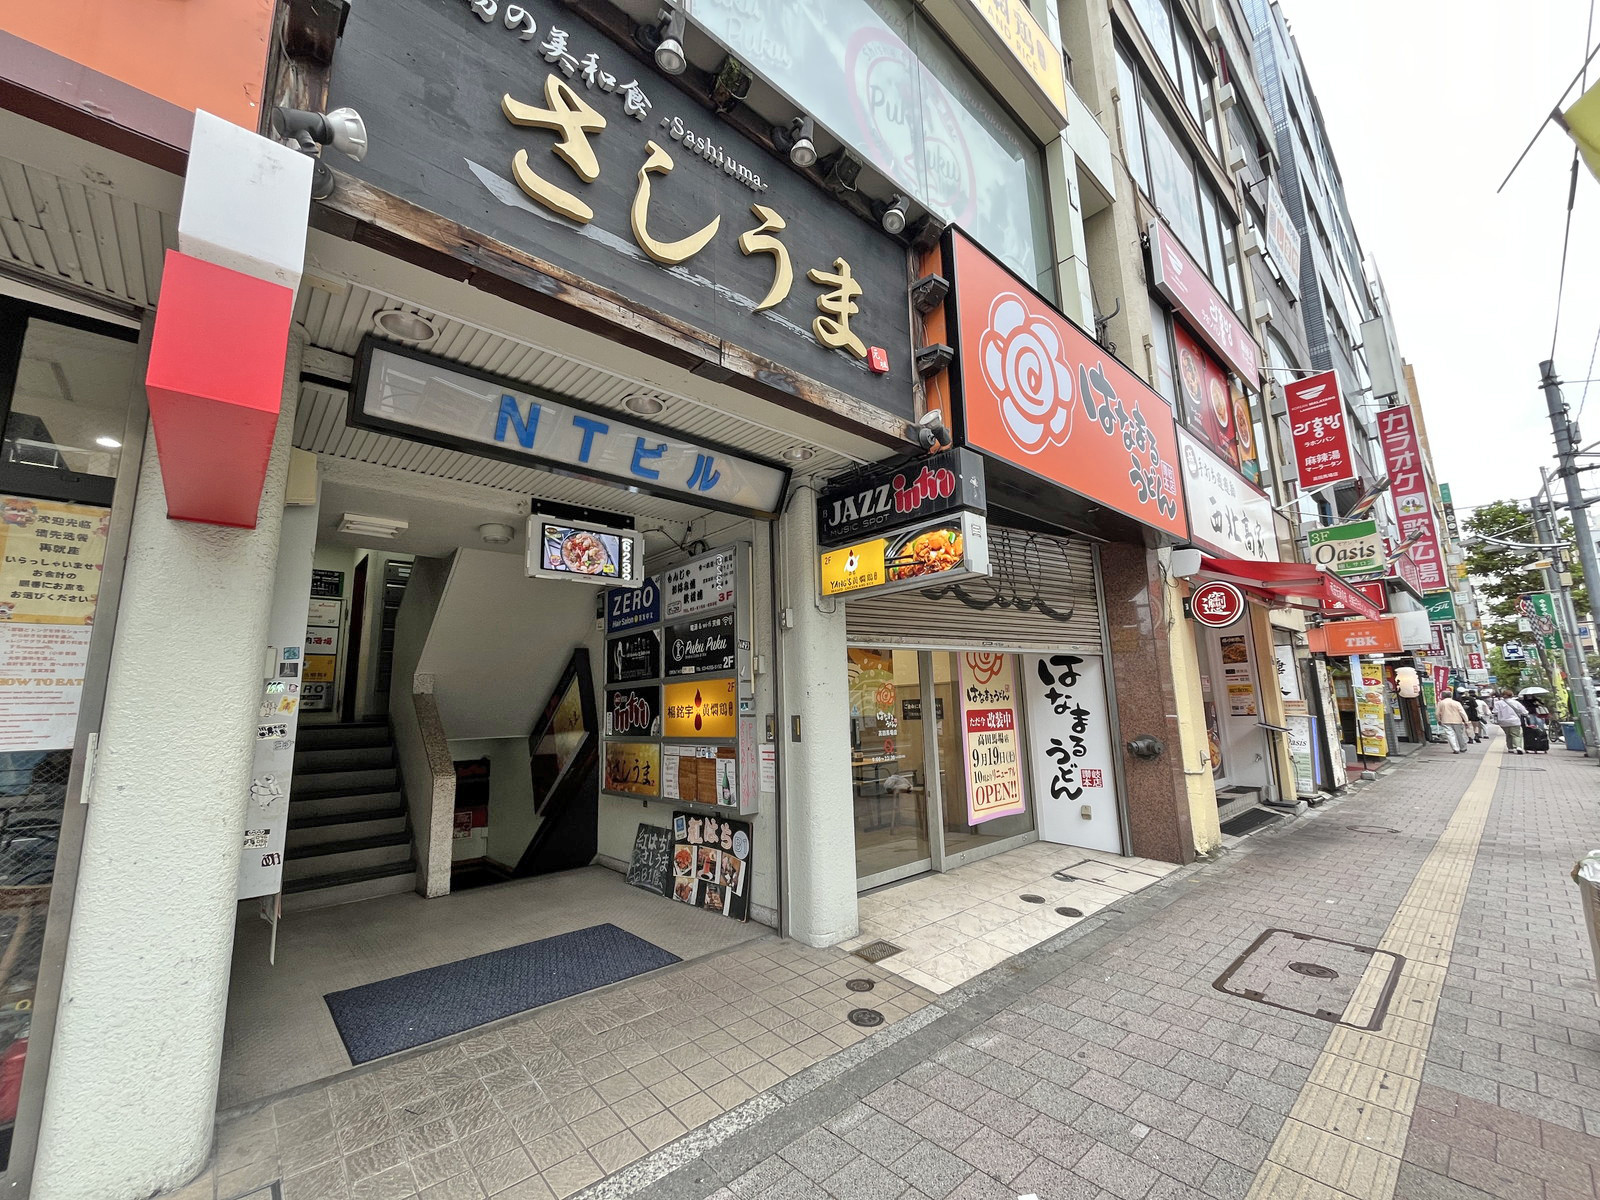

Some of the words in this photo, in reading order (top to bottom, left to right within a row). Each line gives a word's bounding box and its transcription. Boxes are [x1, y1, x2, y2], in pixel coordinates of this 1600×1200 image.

[987, 5, 1013, 41] AND
[1015, 42, 1040, 77] RICE
[501, 73, 868, 359] さしうま
[1293, 412, 1341, 438] 라홍방
[494, 394, 721, 491] NTビル
[1382, 412, 1419, 492] カラオケ
[1305, 449, 1341, 467] 麻辣湯
[1305, 460, 1343, 473] マーラータン
[828, 484, 892, 527] JAZZ
[892, 465, 956, 514] intro
[830, 521, 858, 536] MUSIC
[862, 513, 891, 528] SPOT
[1311, 530, 1330, 544] 3F
[824, 556, 832, 566] 2F
[1315, 540, 1376, 565] Oasis
[5, 555, 94, 570] いらっしゃいませ
[33, 569, 77, 579] お会計の
[10, 590, 88, 603] お選びください
[613, 586, 654, 616] ZERO
[718, 590, 734, 602] 3F
[685, 639, 705, 655] Puku
[705, 634, 727, 651] Puku
[1344, 635, 1379, 648] TBK
[722, 655, 734, 669] 2F
[35, 677, 54, 687] TO
[56, 677, 84, 687] EAT
[966, 684, 1010, 704] はなまるうどん
[614, 691, 650, 733] intro
[667, 705, 694, 718] 楊銘宇
[969, 711, 1011, 729] ただ今改装中
[1037, 654, 1091, 801] はなまるうどん
[977, 733, 1010, 746] 高田馬場店
[975, 780, 1018, 806] OPEN!!
